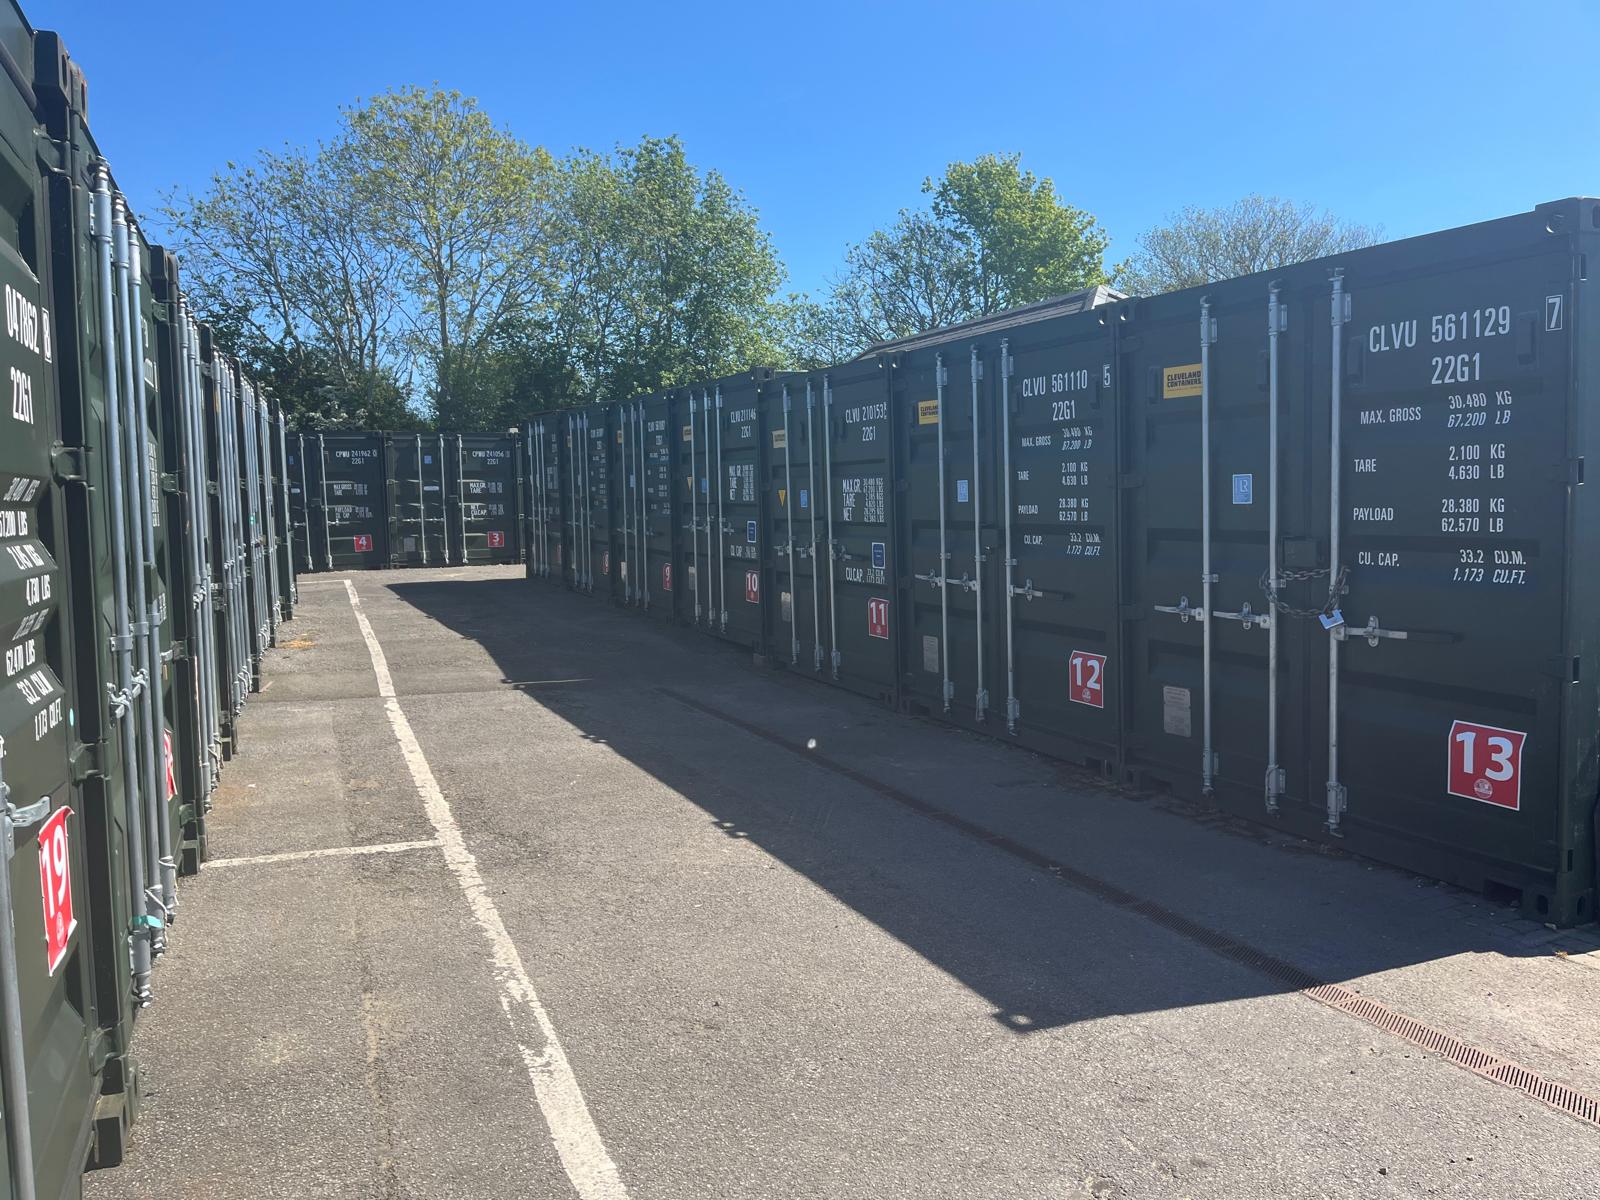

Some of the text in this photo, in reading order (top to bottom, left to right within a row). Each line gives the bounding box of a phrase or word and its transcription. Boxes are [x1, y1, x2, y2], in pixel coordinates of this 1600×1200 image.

[5, 283, 40, 354] 047862
[1369, 297, 1561, 352] CLVU 561129 7
[1167, 370, 1202, 381] CLEVELAND
[1431, 352, 1480, 384] 22G1
[1023, 366, 1110, 397] CLVU 561110 5
[1167, 378, 1202, 388] CONTAINERS
[11, 366, 34, 425] 22G1
[1495, 390, 1512, 405] KG
[1052, 400, 1076, 421] 22G1
[1360, 406, 1422, 424] MAX. GROSS
[1495, 409, 1511, 425] LB
[1490, 443, 1505, 459] KG
[1080, 462, 1088, 472] KG
[1354, 458, 1377, 473] TARE
[1490, 464, 1505, 479] LB
[1017, 470, 1029, 481] TARE
[1080, 475, 1088, 485] LB
[842, 493, 856, 507] TARE
[1081, 498, 1089, 508] KG
[1489, 498, 1505, 513] KG
[843, 507, 852, 521] NET
[1018, 504, 1039, 515] PAYLOAD
[1353, 507, 1394, 521] PAYLOAD
[1489, 517, 1504, 533] LB
[359, 536, 367, 546] 4
[492, 533, 500, 542] 3
[1358, 552, 1400, 567] CU. CAP.
[1460, 549, 1527, 565] 33.2 CU.M.
[747, 573, 758, 592] 10
[1492, 569, 1526, 584] CU.FT.
[870, 601, 886, 625] 11
[1072, 657, 1100, 690] 12
[1456, 731, 1514, 782] 13
[41, 825, 66, 918] 19
